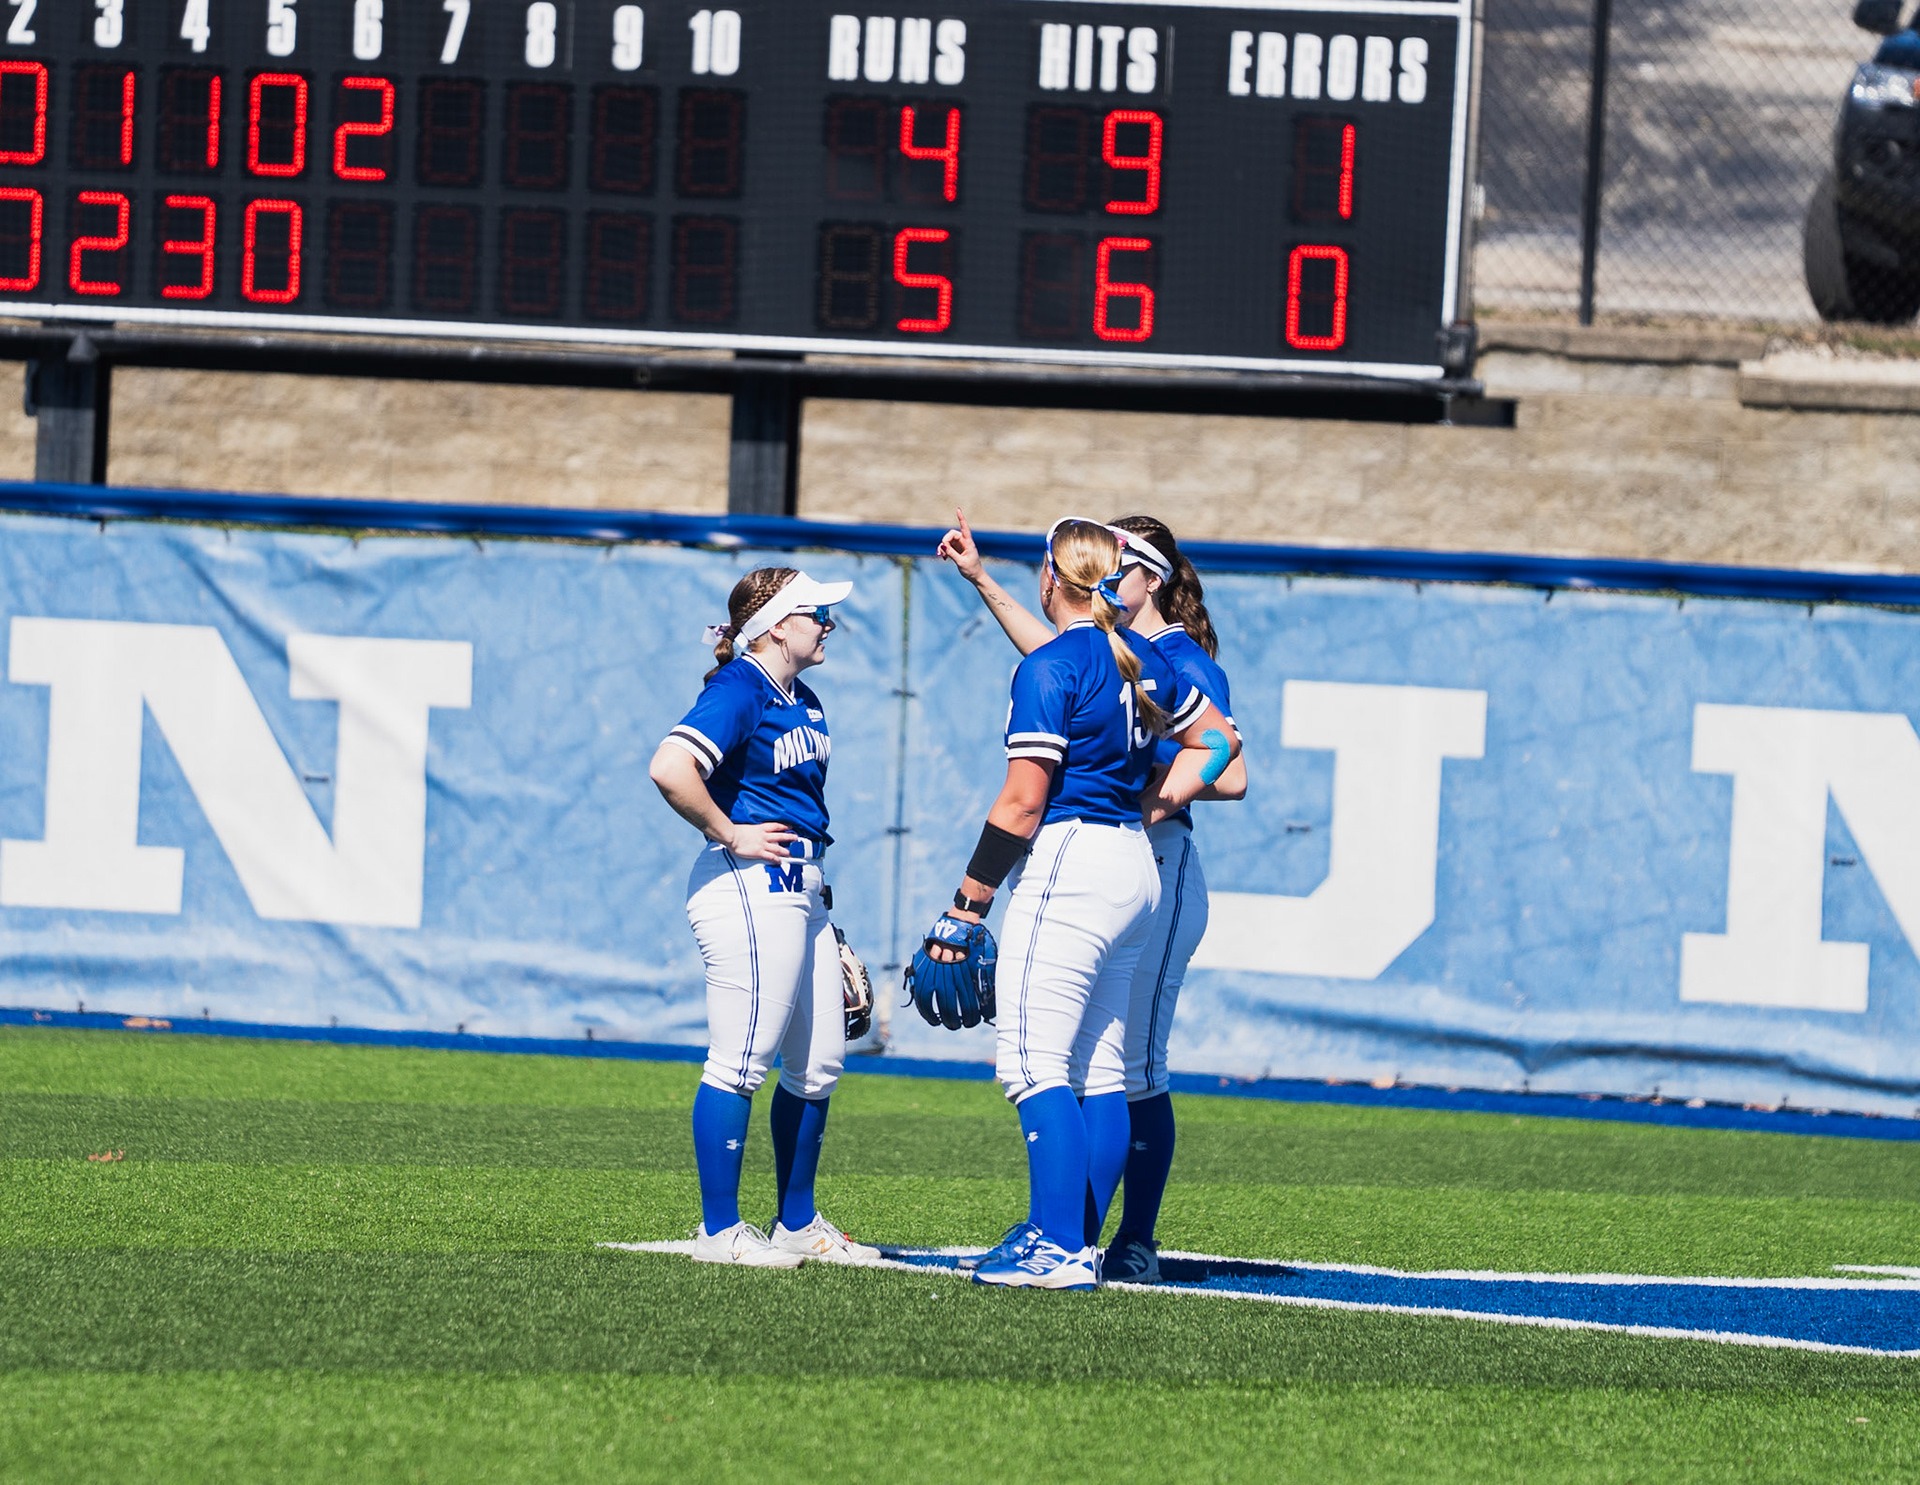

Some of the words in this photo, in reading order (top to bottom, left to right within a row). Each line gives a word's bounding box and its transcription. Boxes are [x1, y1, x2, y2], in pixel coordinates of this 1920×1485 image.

[8, 0, 37, 44] 2
[95, 0, 124, 48] 3
[181, 0, 210, 53] 4
[267, 0, 297, 57] 5
[353, 0, 383, 60] 6
[441, 0, 471, 64] 7
[525, 1, 557, 67] 8
[612, 5, 644, 71] 9
[689, 9, 742, 75] 10
[828, 14, 967, 85] RUNS
[1039, 23, 1158, 94] HITS
[1228, 30, 1429, 104] ERRORS
[121, 71, 135, 165] 1
[207, 75, 221, 168] 1
[247, 73, 308, 177] 0
[334, 77, 395, 181] 2
[900, 106, 961, 202] 4
[1103, 110, 1163, 215] 9
[1338, 124, 1356, 219] 1
[69, 191, 130, 295] 2
[161, 195, 217, 299] 3
[242, 199, 302, 304] 0
[893, 228, 953, 333] 5
[1093, 237, 1155, 342] 6
[1286, 245, 1349, 351] 0
[1, 615, 473, 929] N
[764, 863, 803, 893] M
